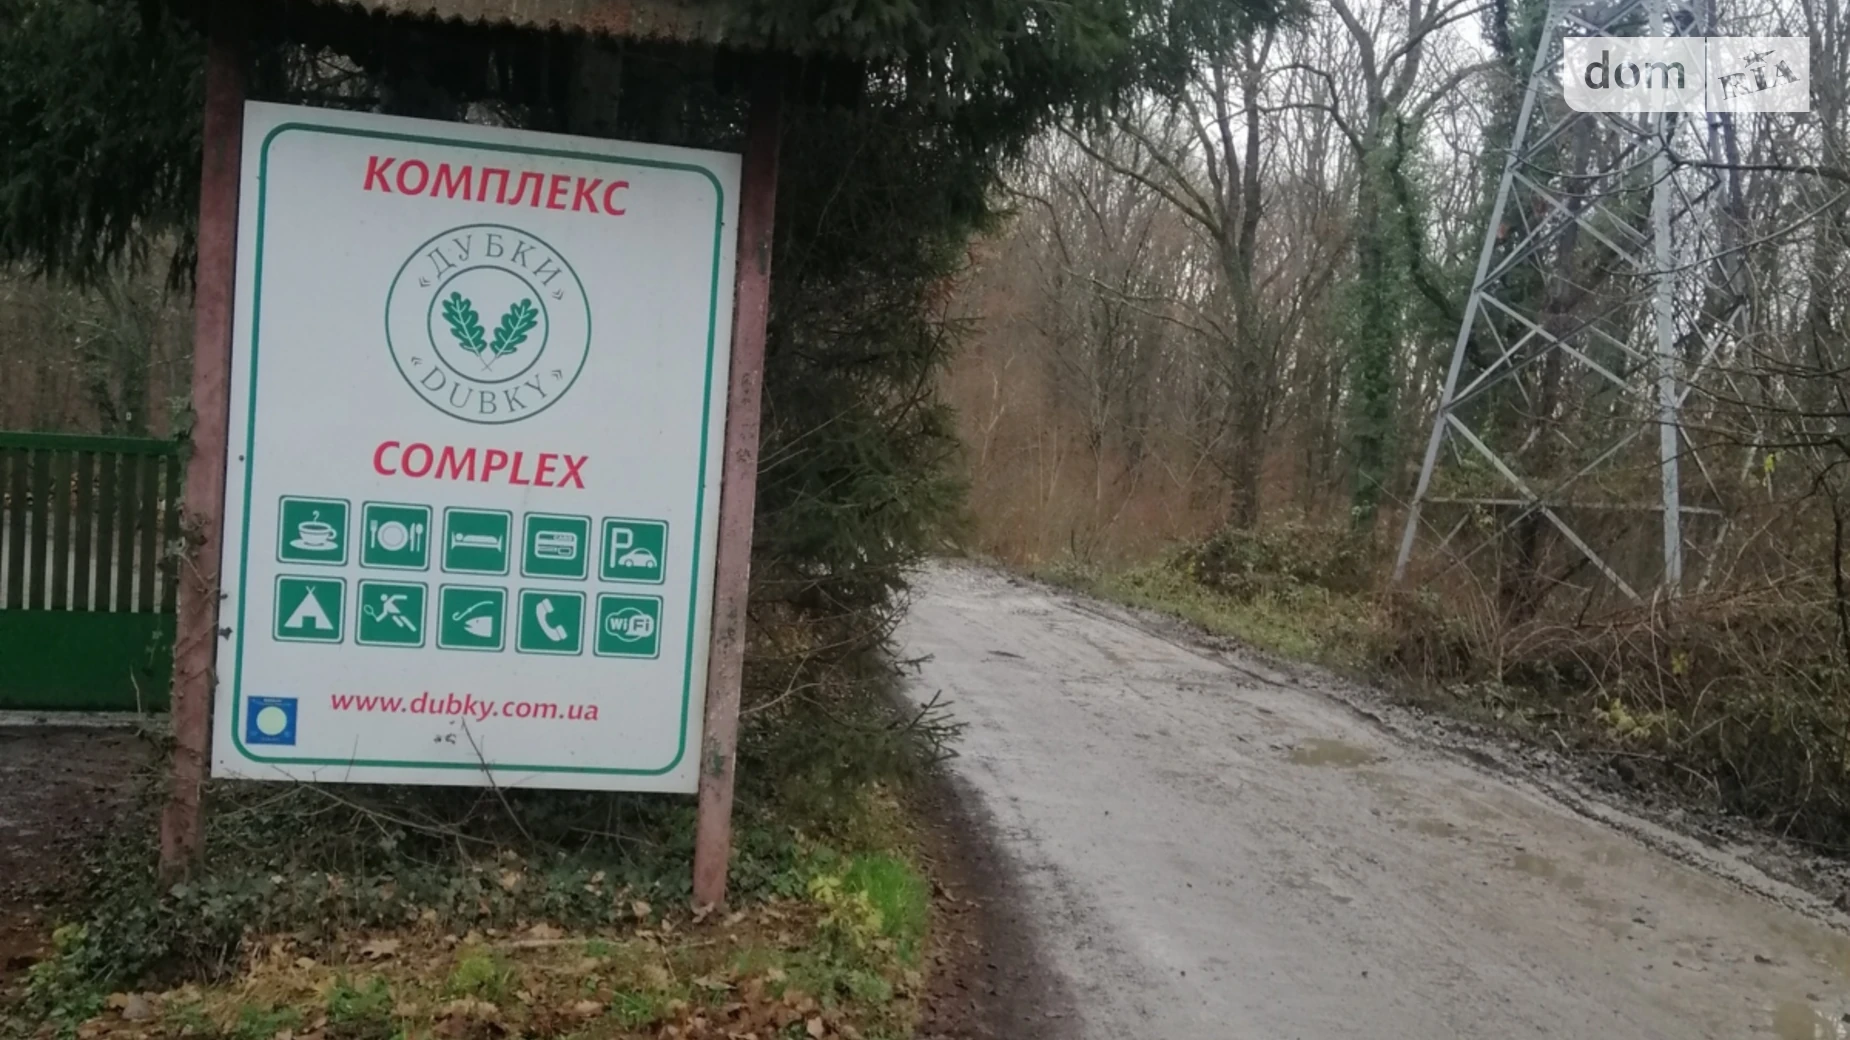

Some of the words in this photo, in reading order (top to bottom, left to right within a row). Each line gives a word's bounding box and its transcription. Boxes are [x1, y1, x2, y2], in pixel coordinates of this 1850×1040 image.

[363, 155, 630, 216] КОМПЛЕКС
[373, 440, 589, 489] COMPLEX
[609, 527, 634, 569] P
[330, 691, 599, 722] www.dubky.com.ua
